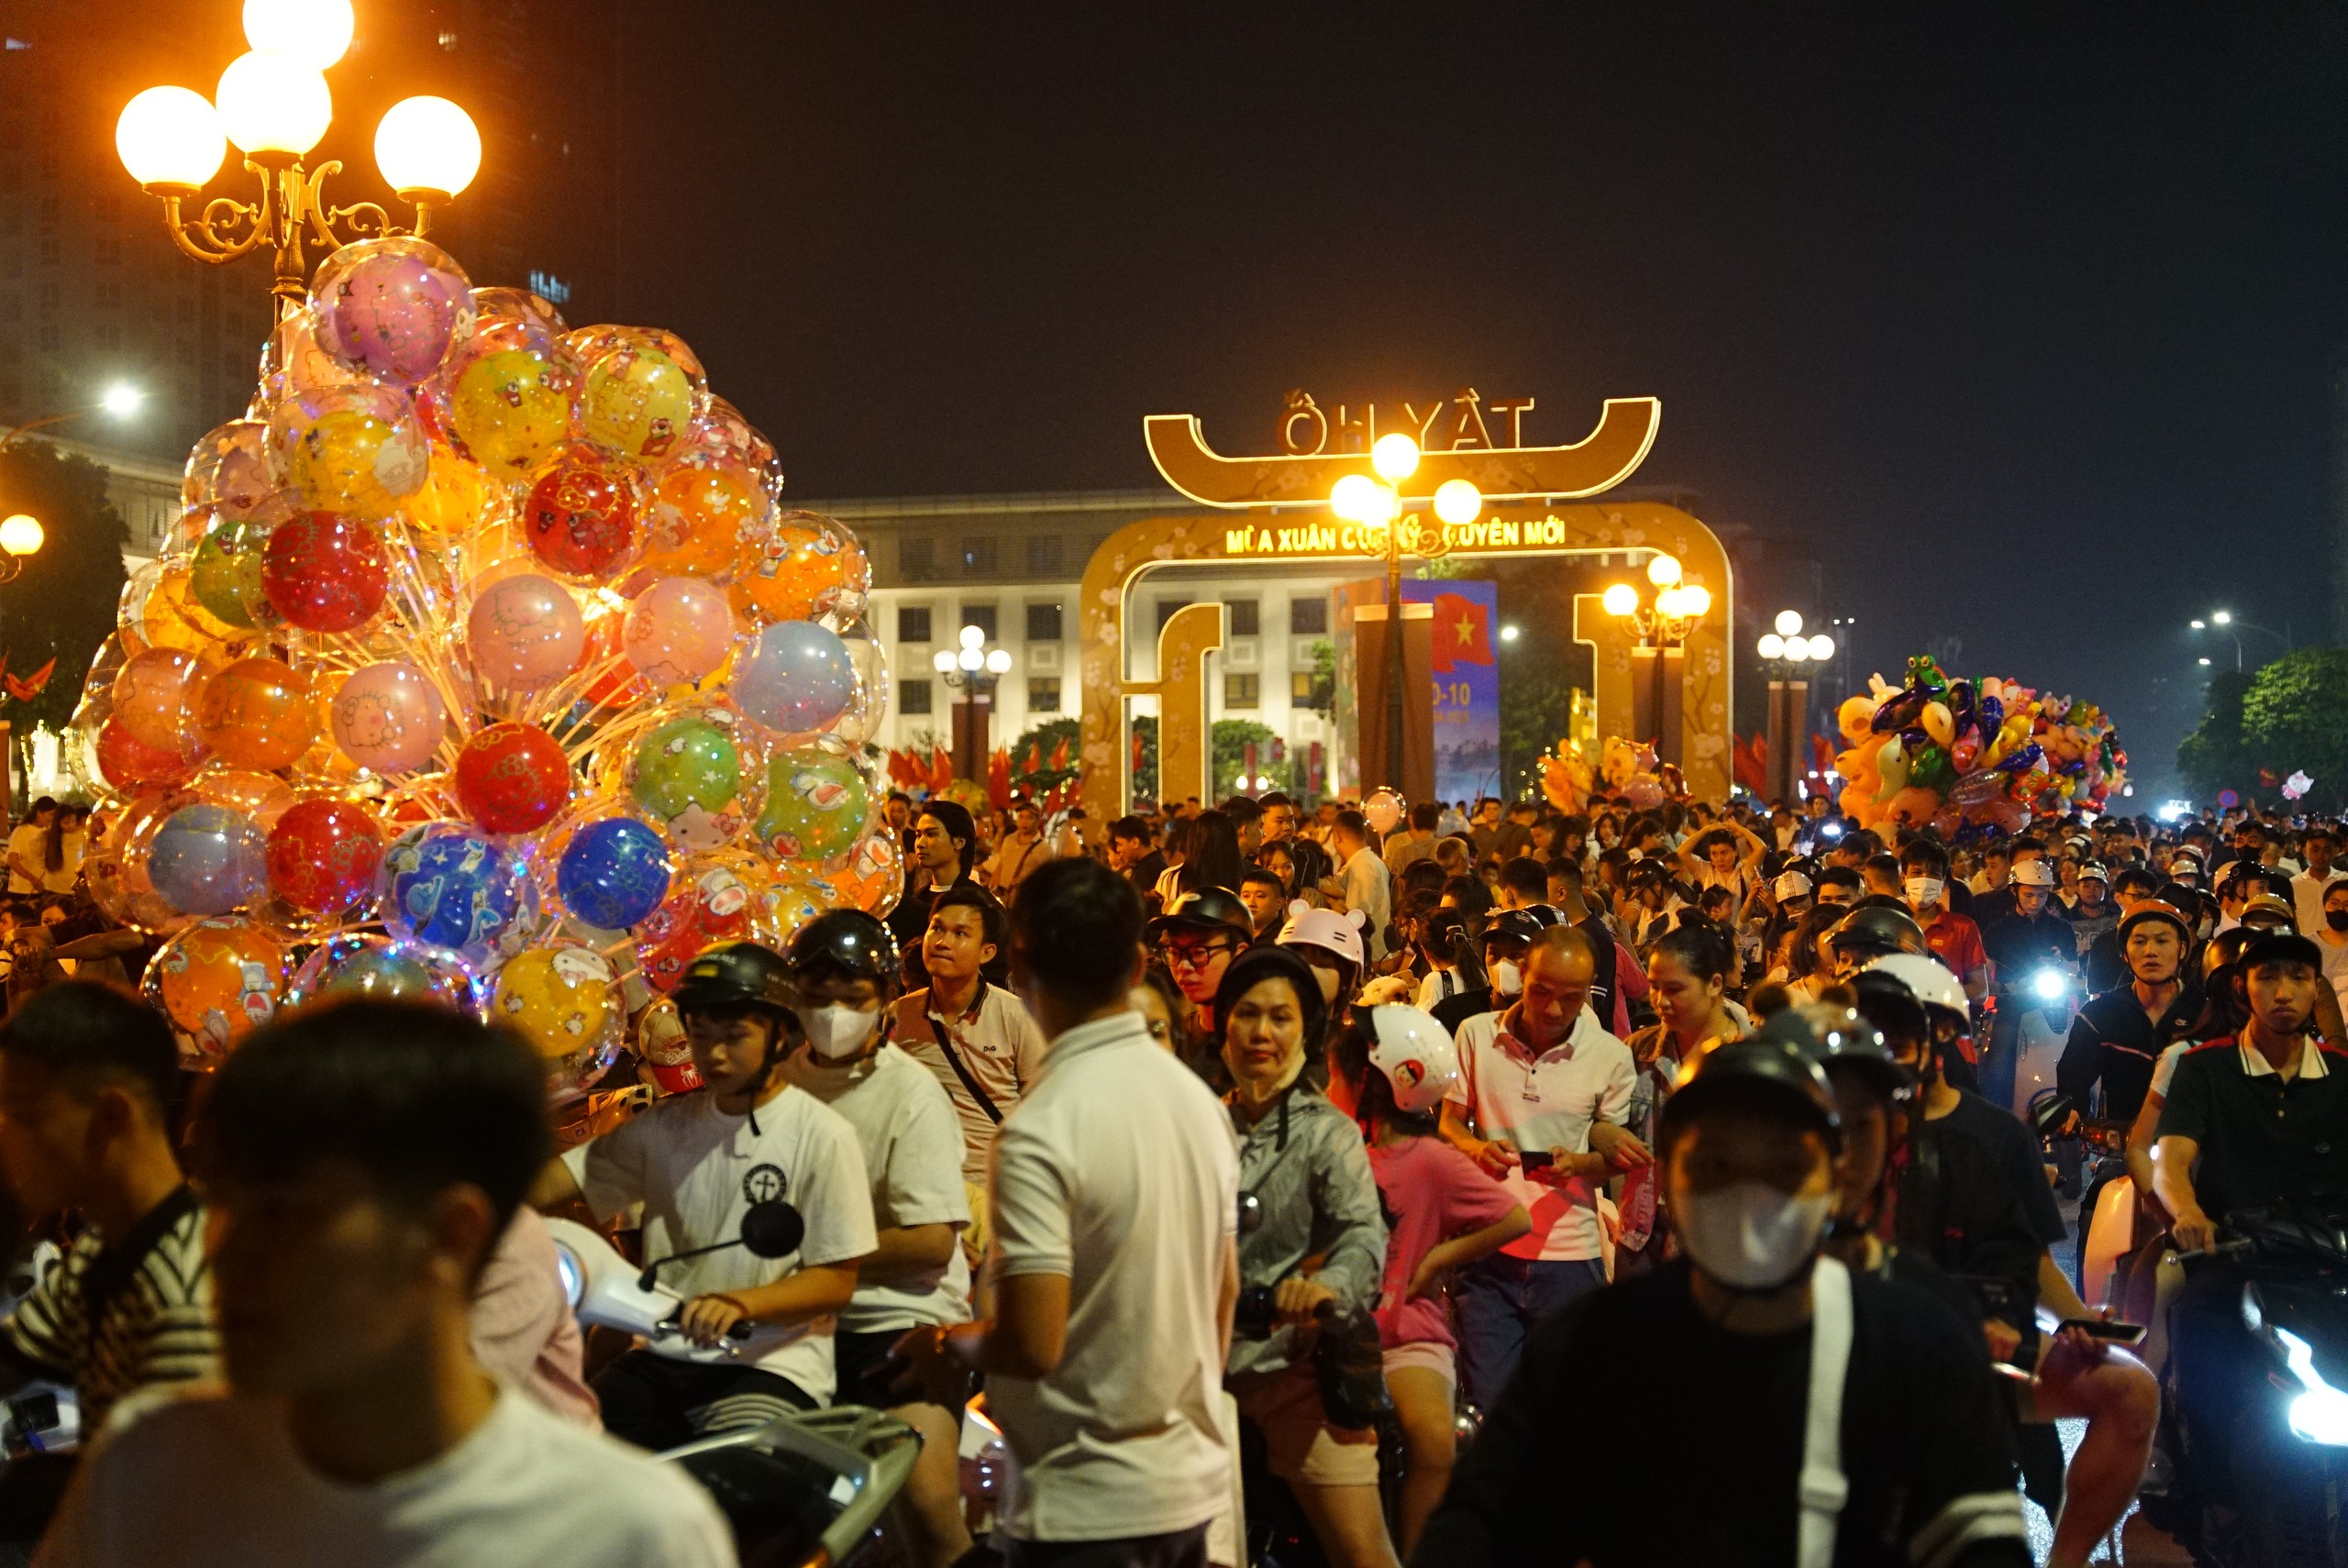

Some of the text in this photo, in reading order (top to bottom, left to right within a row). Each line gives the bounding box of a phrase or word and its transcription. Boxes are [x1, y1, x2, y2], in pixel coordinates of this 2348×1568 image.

[1278, 523, 1336, 552] XUÂN
[1524, 514, 1565, 545] MỚI
[1432, 682, 1470, 706] 0-10
